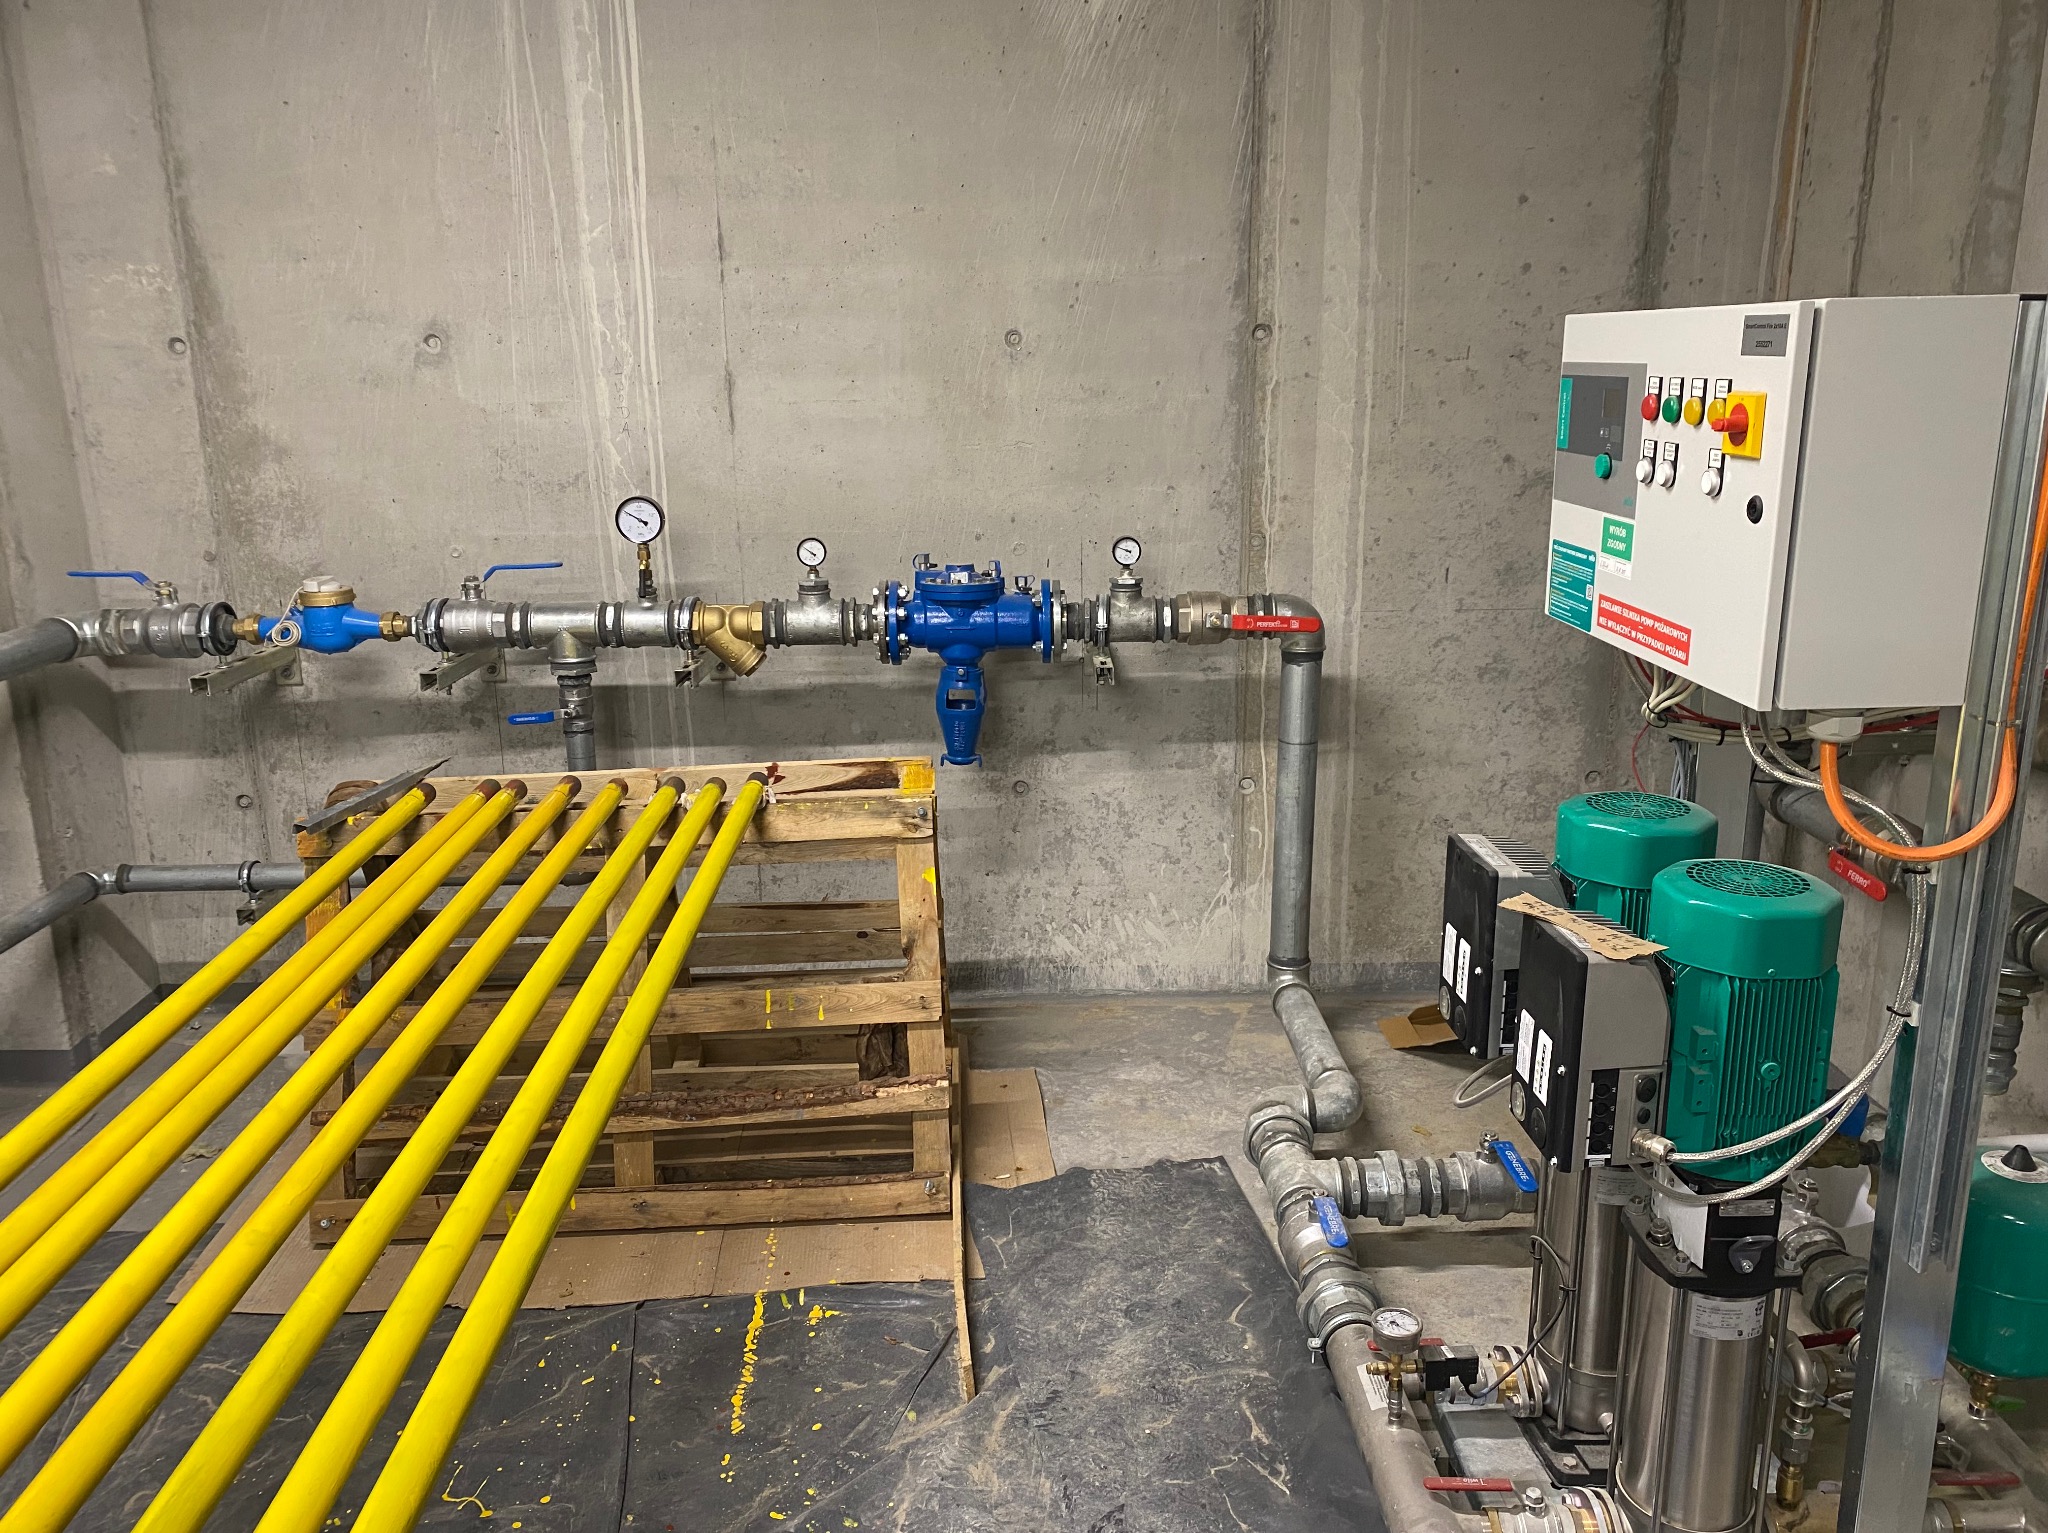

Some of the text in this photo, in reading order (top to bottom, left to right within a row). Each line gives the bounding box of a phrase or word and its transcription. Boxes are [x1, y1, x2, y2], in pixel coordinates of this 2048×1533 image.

[1607, 538, 1626, 551] ZGODNY
[1610, 525, 1626, 538] WYRÓB
[1600, 600, 1622, 614] ZASILANIE
[1623, 607, 1640, 622] SILNIKA
[1641, 616, 1654, 626] POMP
[1654, 622, 1688, 642] POŻAROWYCH
[1599, 616, 1686, 660] NIE WYŁĄCZYĆ W PRZYPADKU POŻARU
[1505, 1150, 1529, 1181] GENEBRE
[1324, 1205, 1339, 1234] GENEBRE
